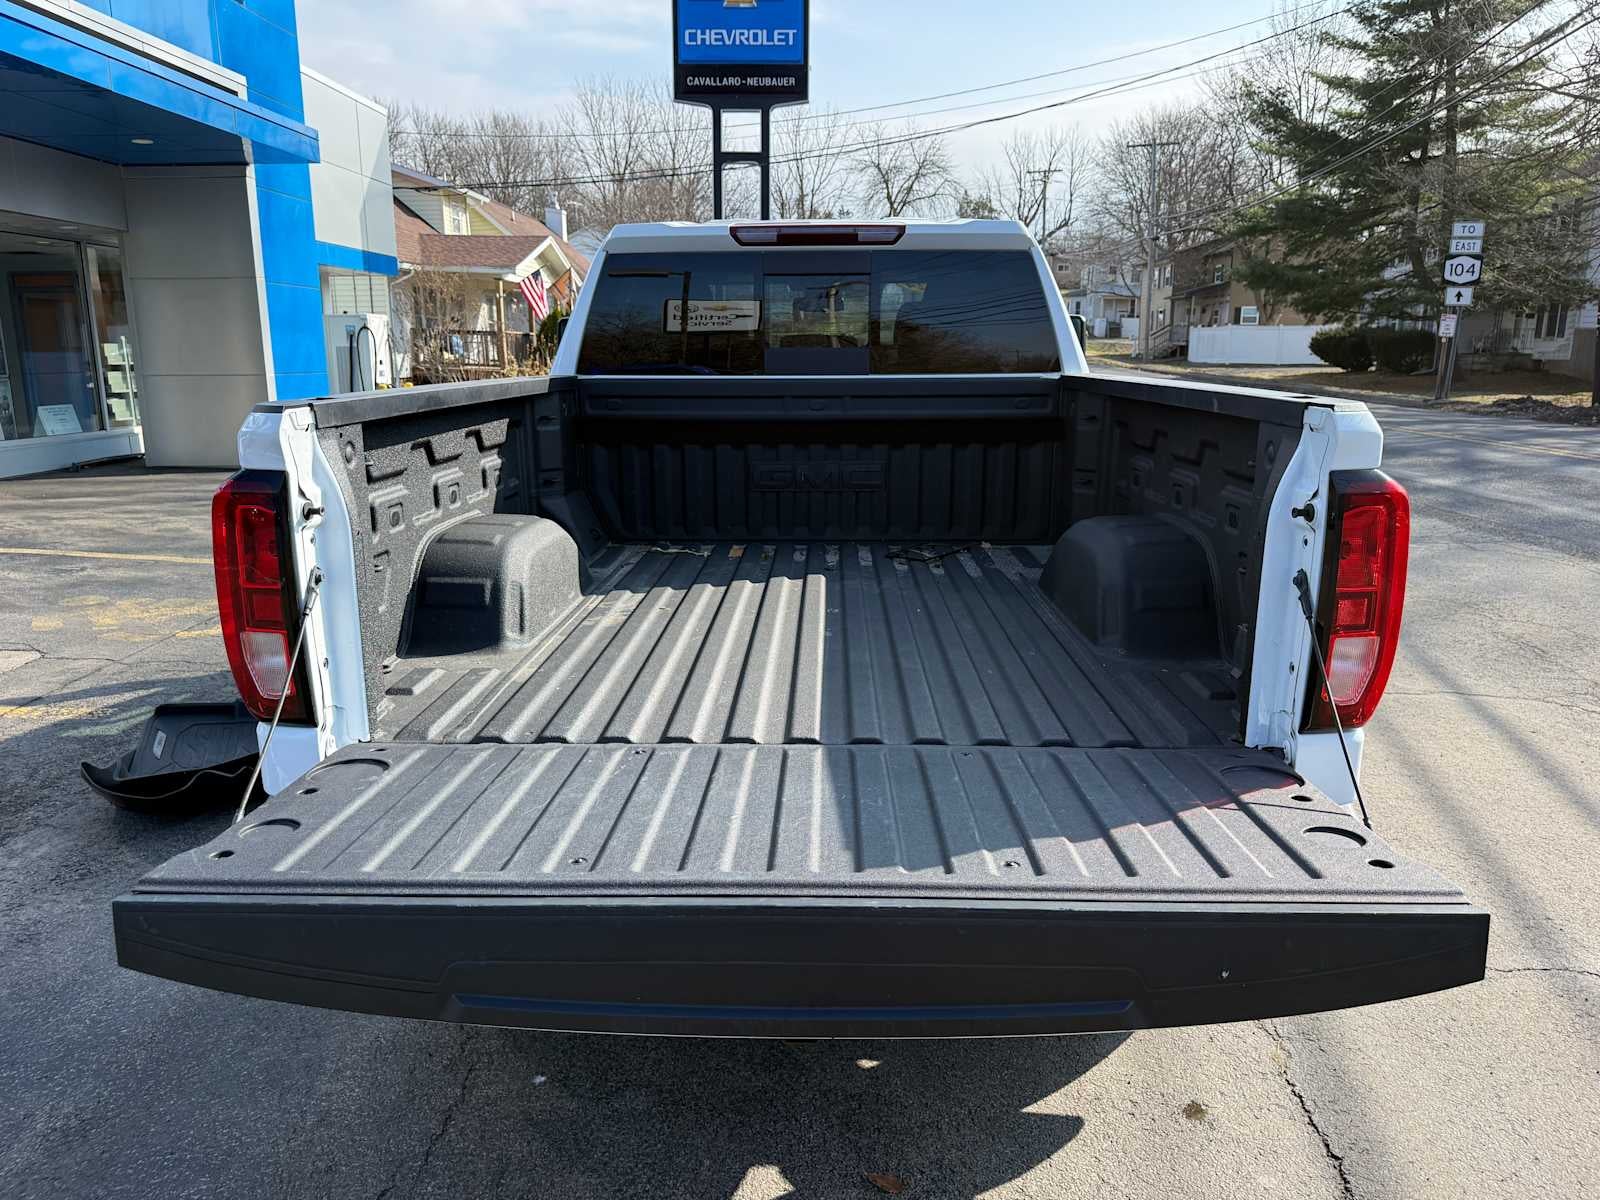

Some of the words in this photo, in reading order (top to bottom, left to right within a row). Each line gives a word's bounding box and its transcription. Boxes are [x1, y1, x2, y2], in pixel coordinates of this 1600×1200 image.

[684, 29, 797, 46] CHEVROLET
[686, 76, 796, 87] CAVALLARO-NEUBAUER
[1461, 225, 1476, 234] TO
[1455, 242, 1477, 251] EAST
[1449, 263, 1476, 277] 104
[751, 462, 886, 494] GMC
